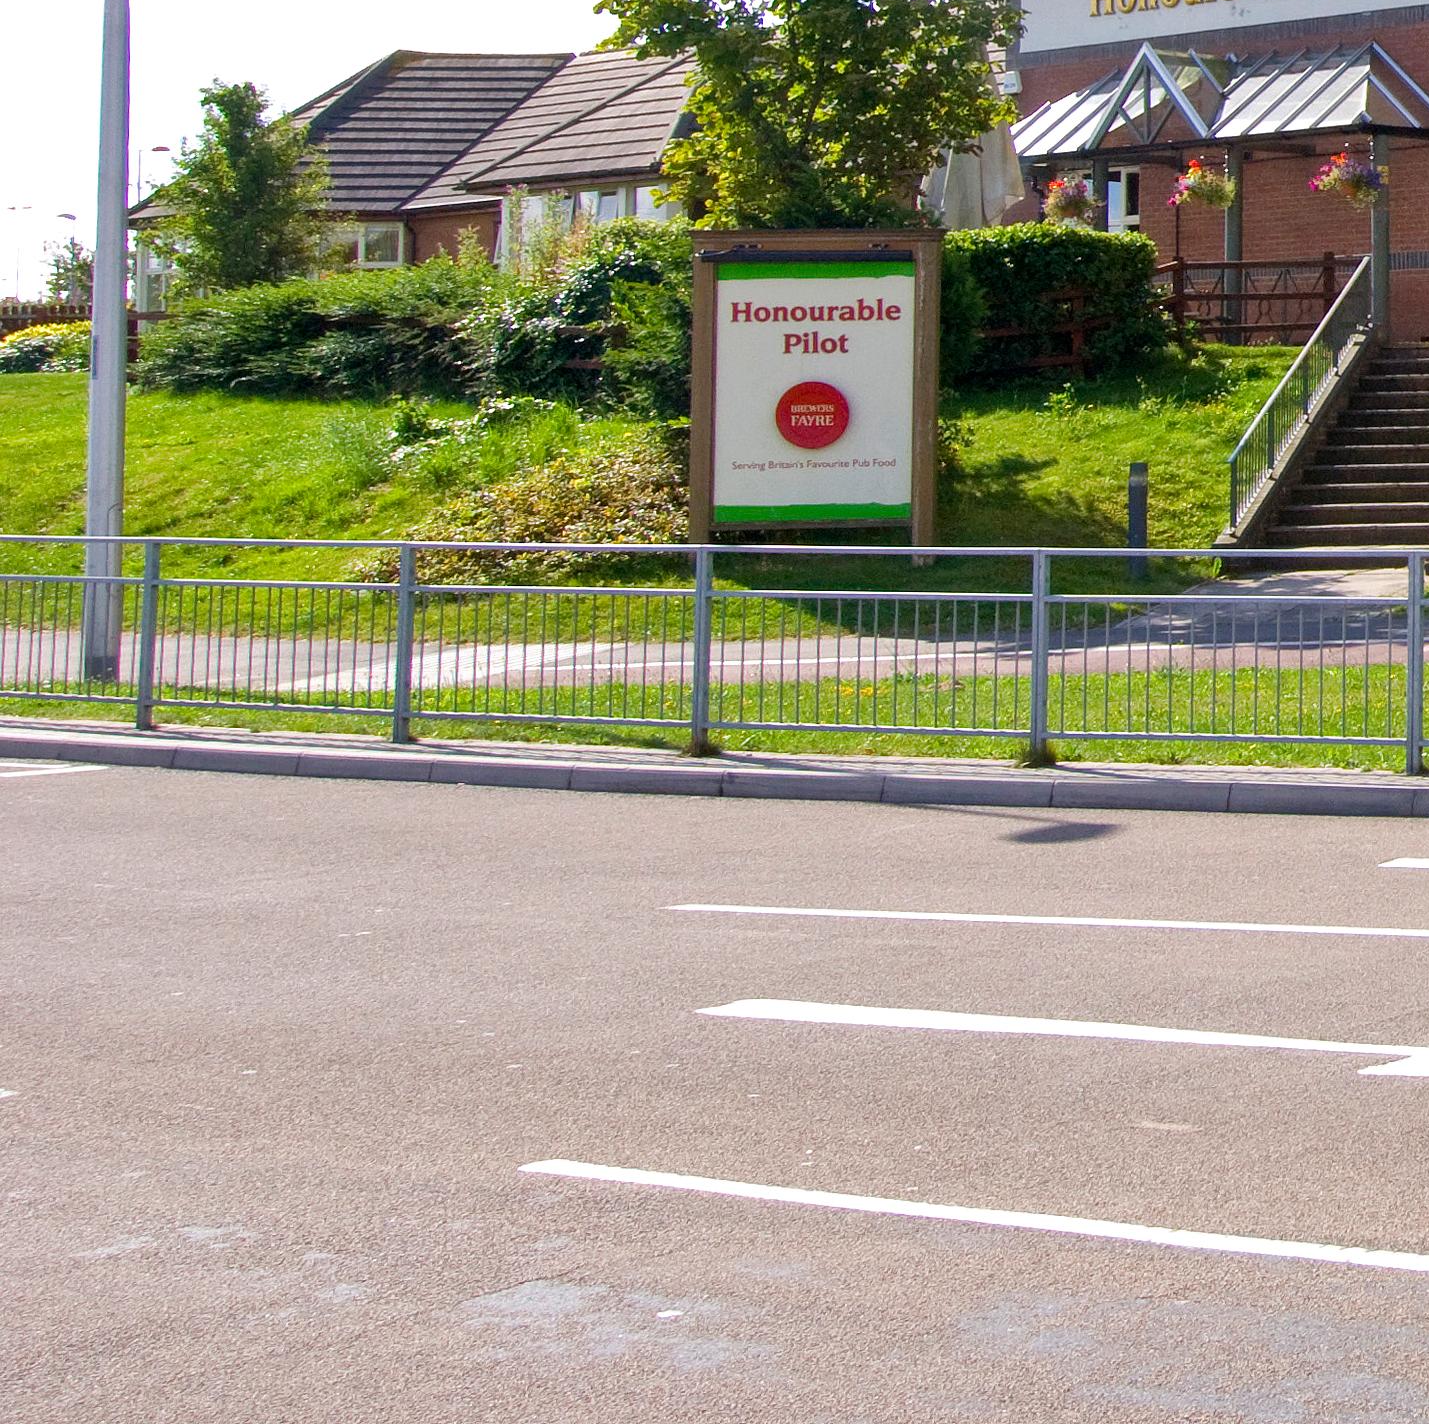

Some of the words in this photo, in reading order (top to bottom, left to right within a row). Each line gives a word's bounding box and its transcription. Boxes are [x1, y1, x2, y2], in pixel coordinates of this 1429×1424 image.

[730, 297, 902, 323] Honourable
[782, 330, 849, 354] Pilot
[790, 404, 834, 413] BREWERS
[791, 414, 834, 426] FAYRE
[731, 460, 766, 471] Serving
[767, 459, 804, 469] Britain's
[806, 458, 850, 469] Favourite
[852, 457, 870, 468] Pub
[872, 457, 897, 467] Food
